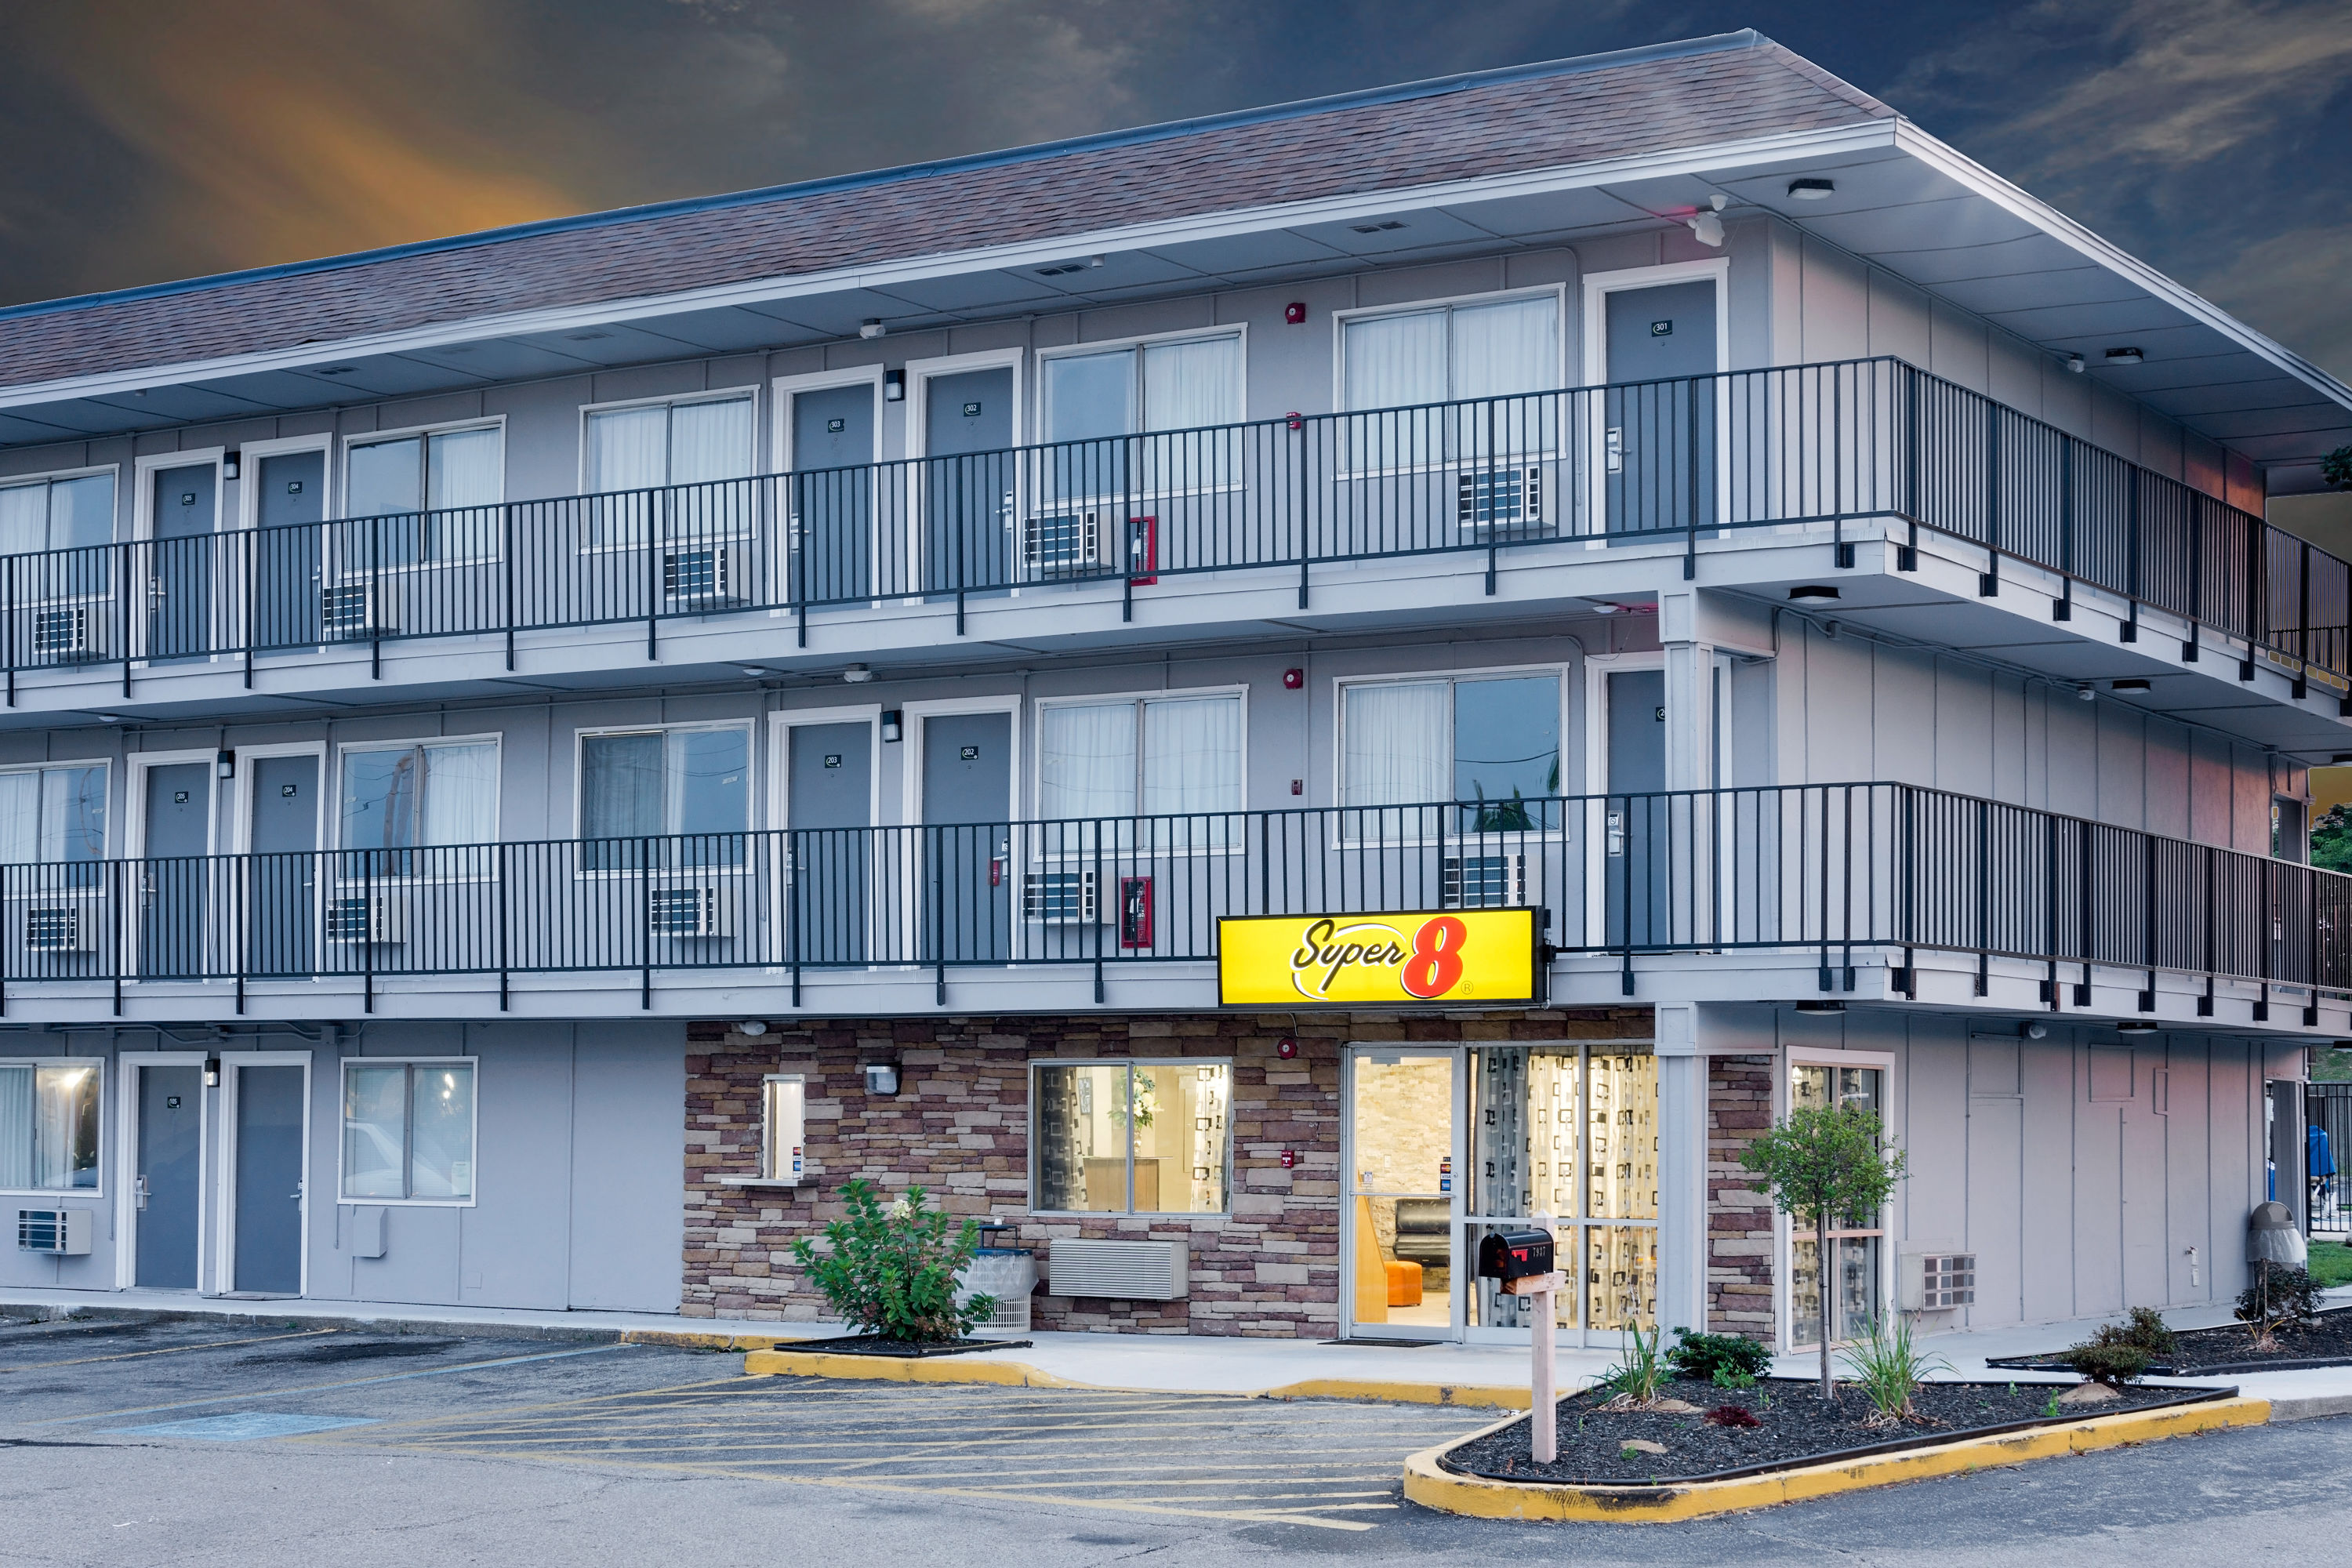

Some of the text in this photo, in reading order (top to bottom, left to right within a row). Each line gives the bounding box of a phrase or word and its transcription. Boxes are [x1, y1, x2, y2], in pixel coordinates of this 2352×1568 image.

[1656, 322, 1668, 331] 301
[1290, 918, 1406, 994] Super
[1400, 916, 1468, 999] 8
[1533, 1247, 1546, 1258] 7937
